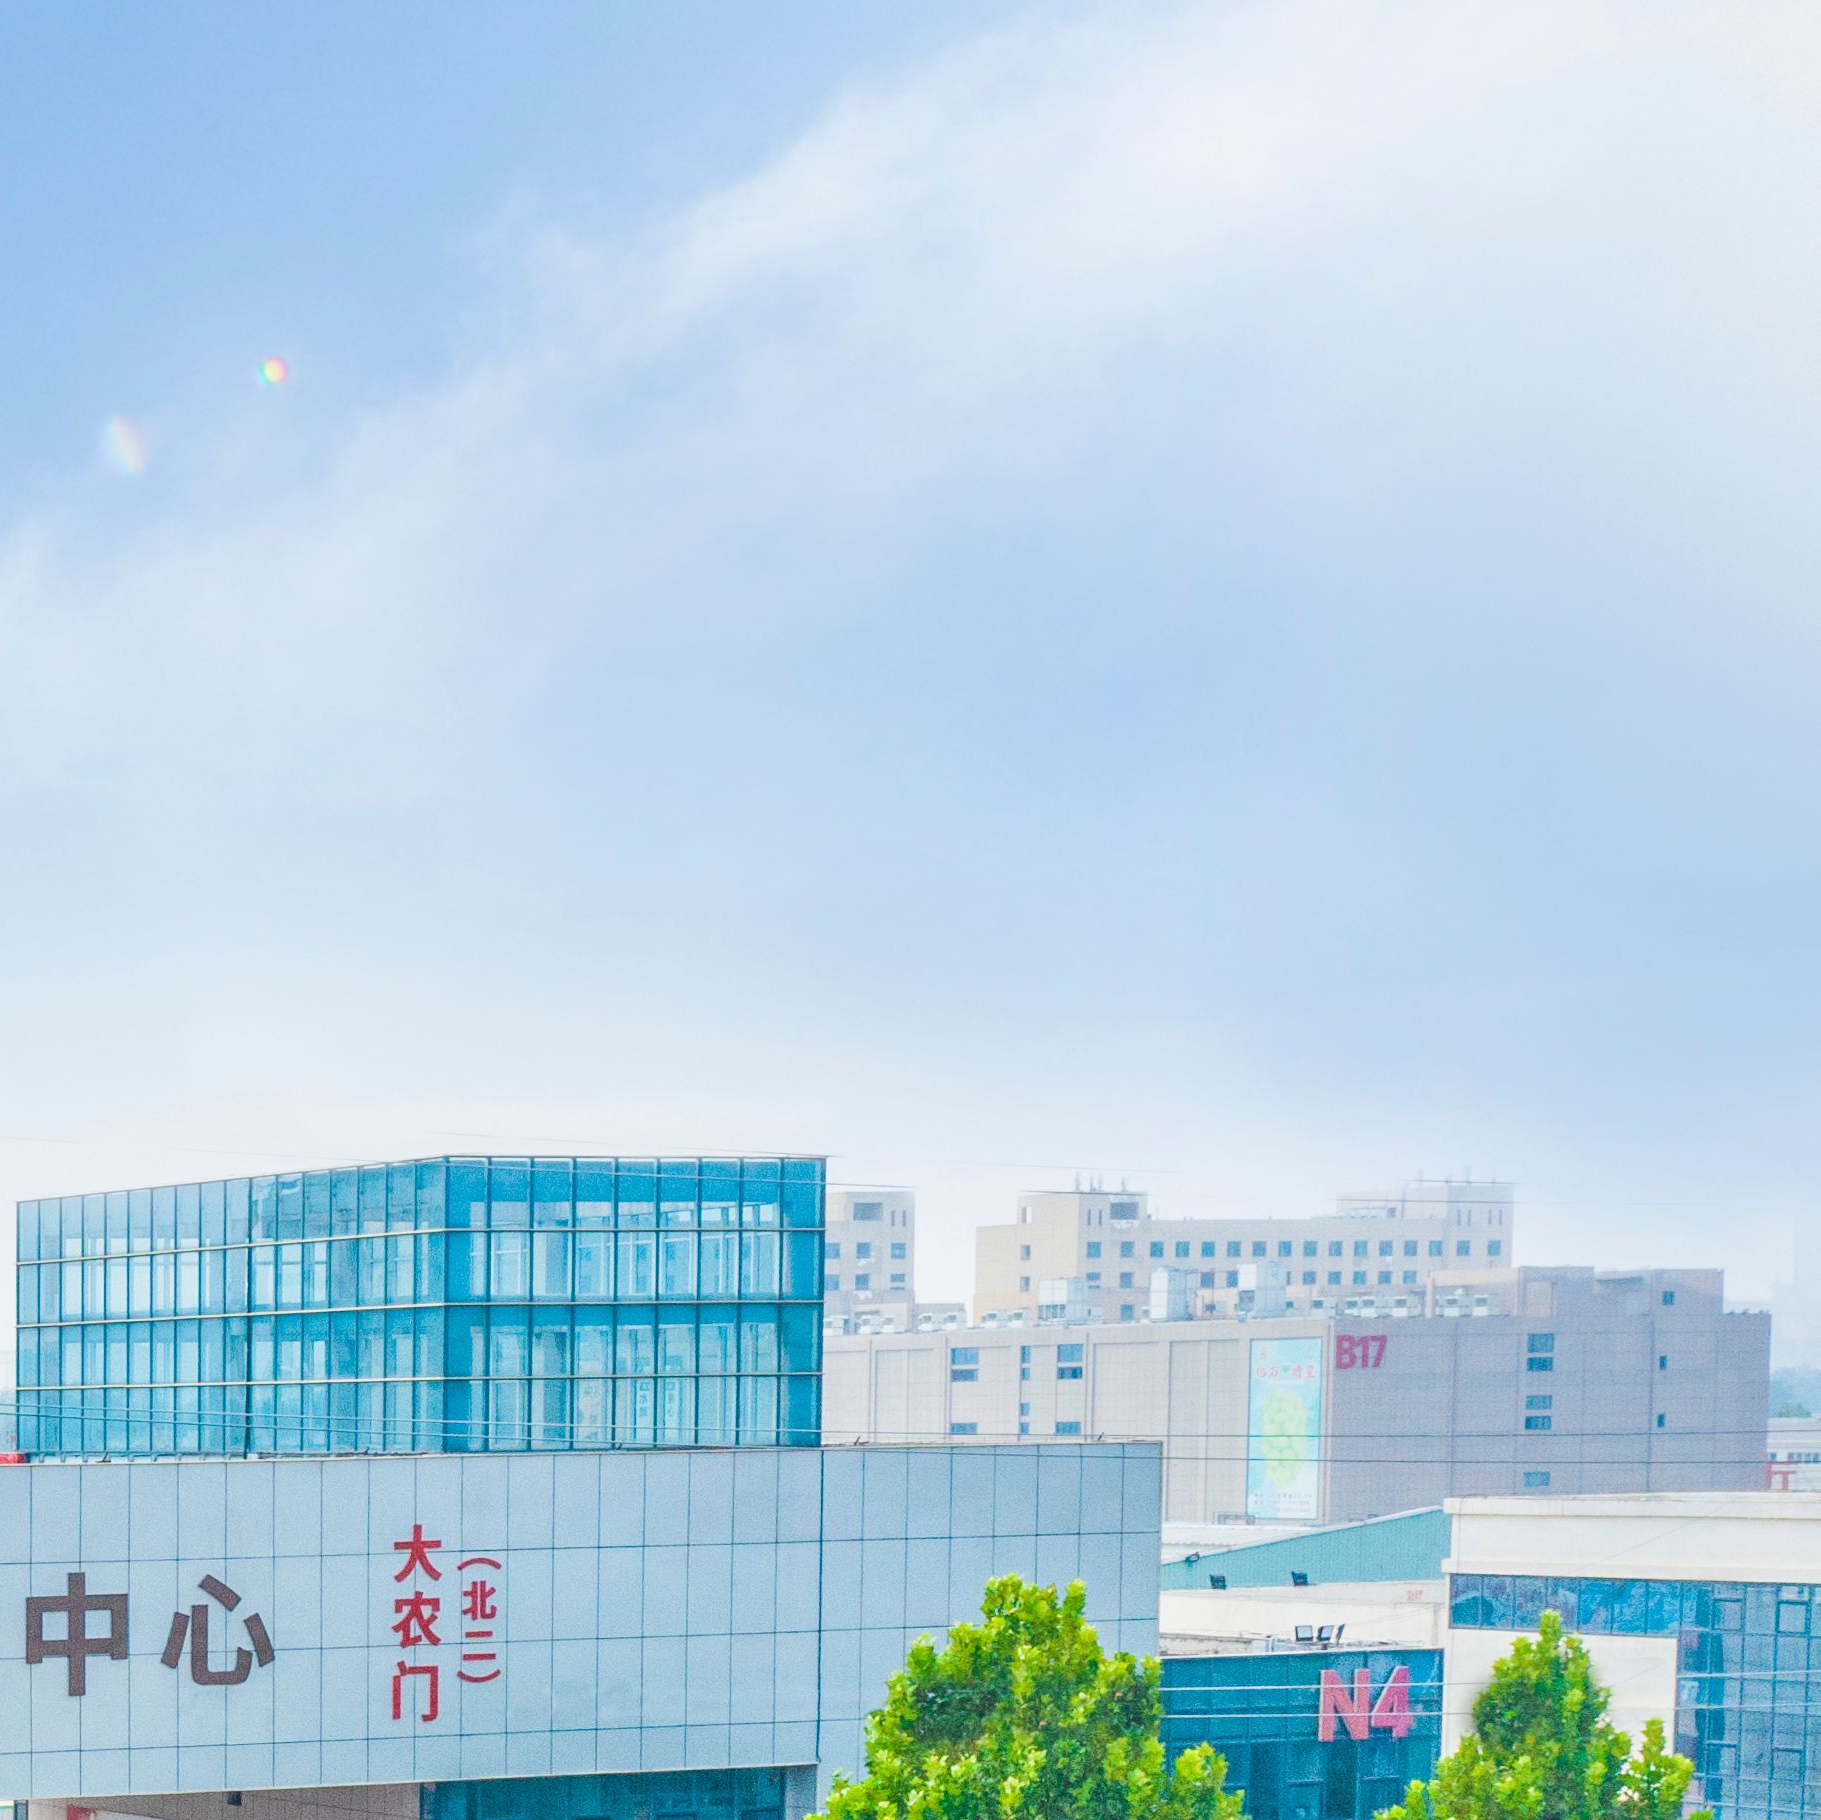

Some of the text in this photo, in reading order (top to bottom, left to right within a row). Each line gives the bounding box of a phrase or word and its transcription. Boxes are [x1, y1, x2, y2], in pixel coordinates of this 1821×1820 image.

[1336, 1335, 1388, 1369] B17
[391, 1524, 443, 1722] 大农门
[1318, 1665, 1414, 1742] N4
